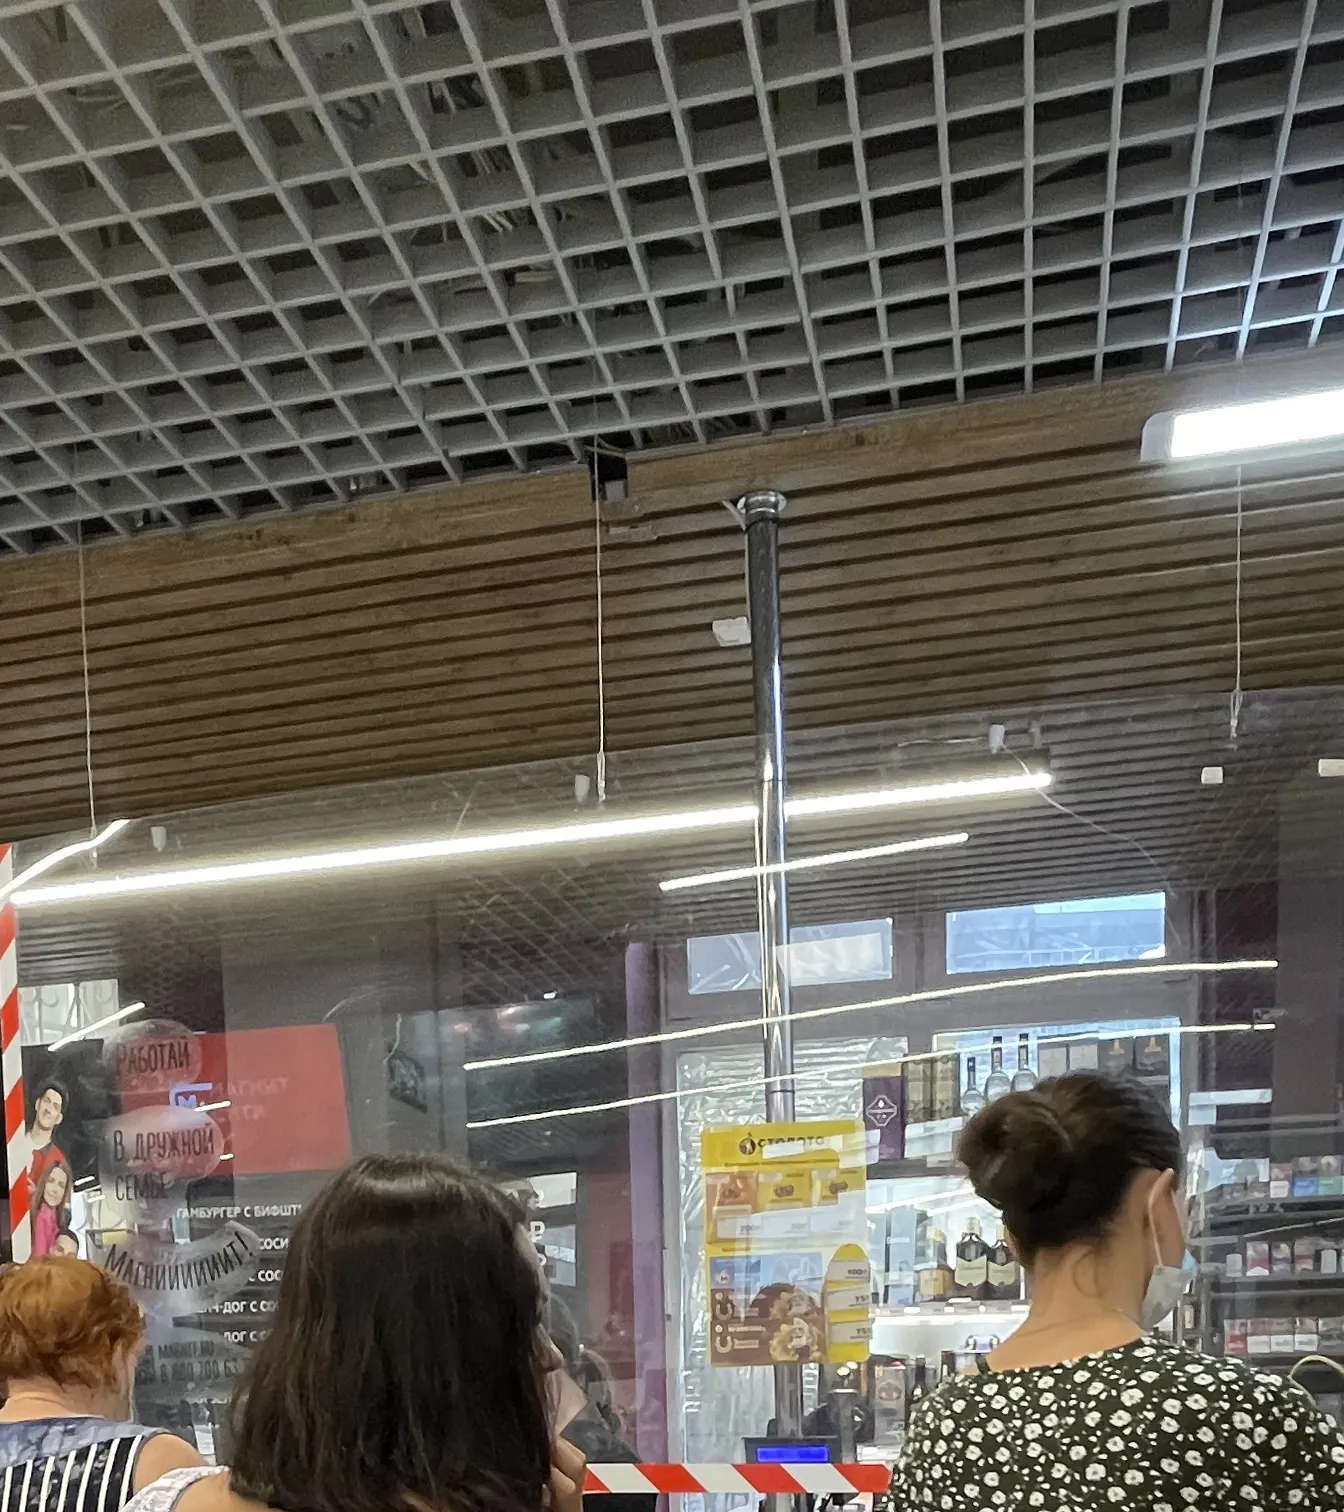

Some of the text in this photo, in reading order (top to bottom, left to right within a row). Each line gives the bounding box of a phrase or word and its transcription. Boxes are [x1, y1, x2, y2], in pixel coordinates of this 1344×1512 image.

[116, 1036, 191, 1075] РАБОТАЙ
[114, 1123, 215, 1162] В ДРУЖНОЙ
[176, 1204, 302, 1219] ГАМБУРГЕР С БИФШТ
[259, 1237, 289, 1250] СОСИ
[203, 1301, 245, 1315] Ч-ДОГ
